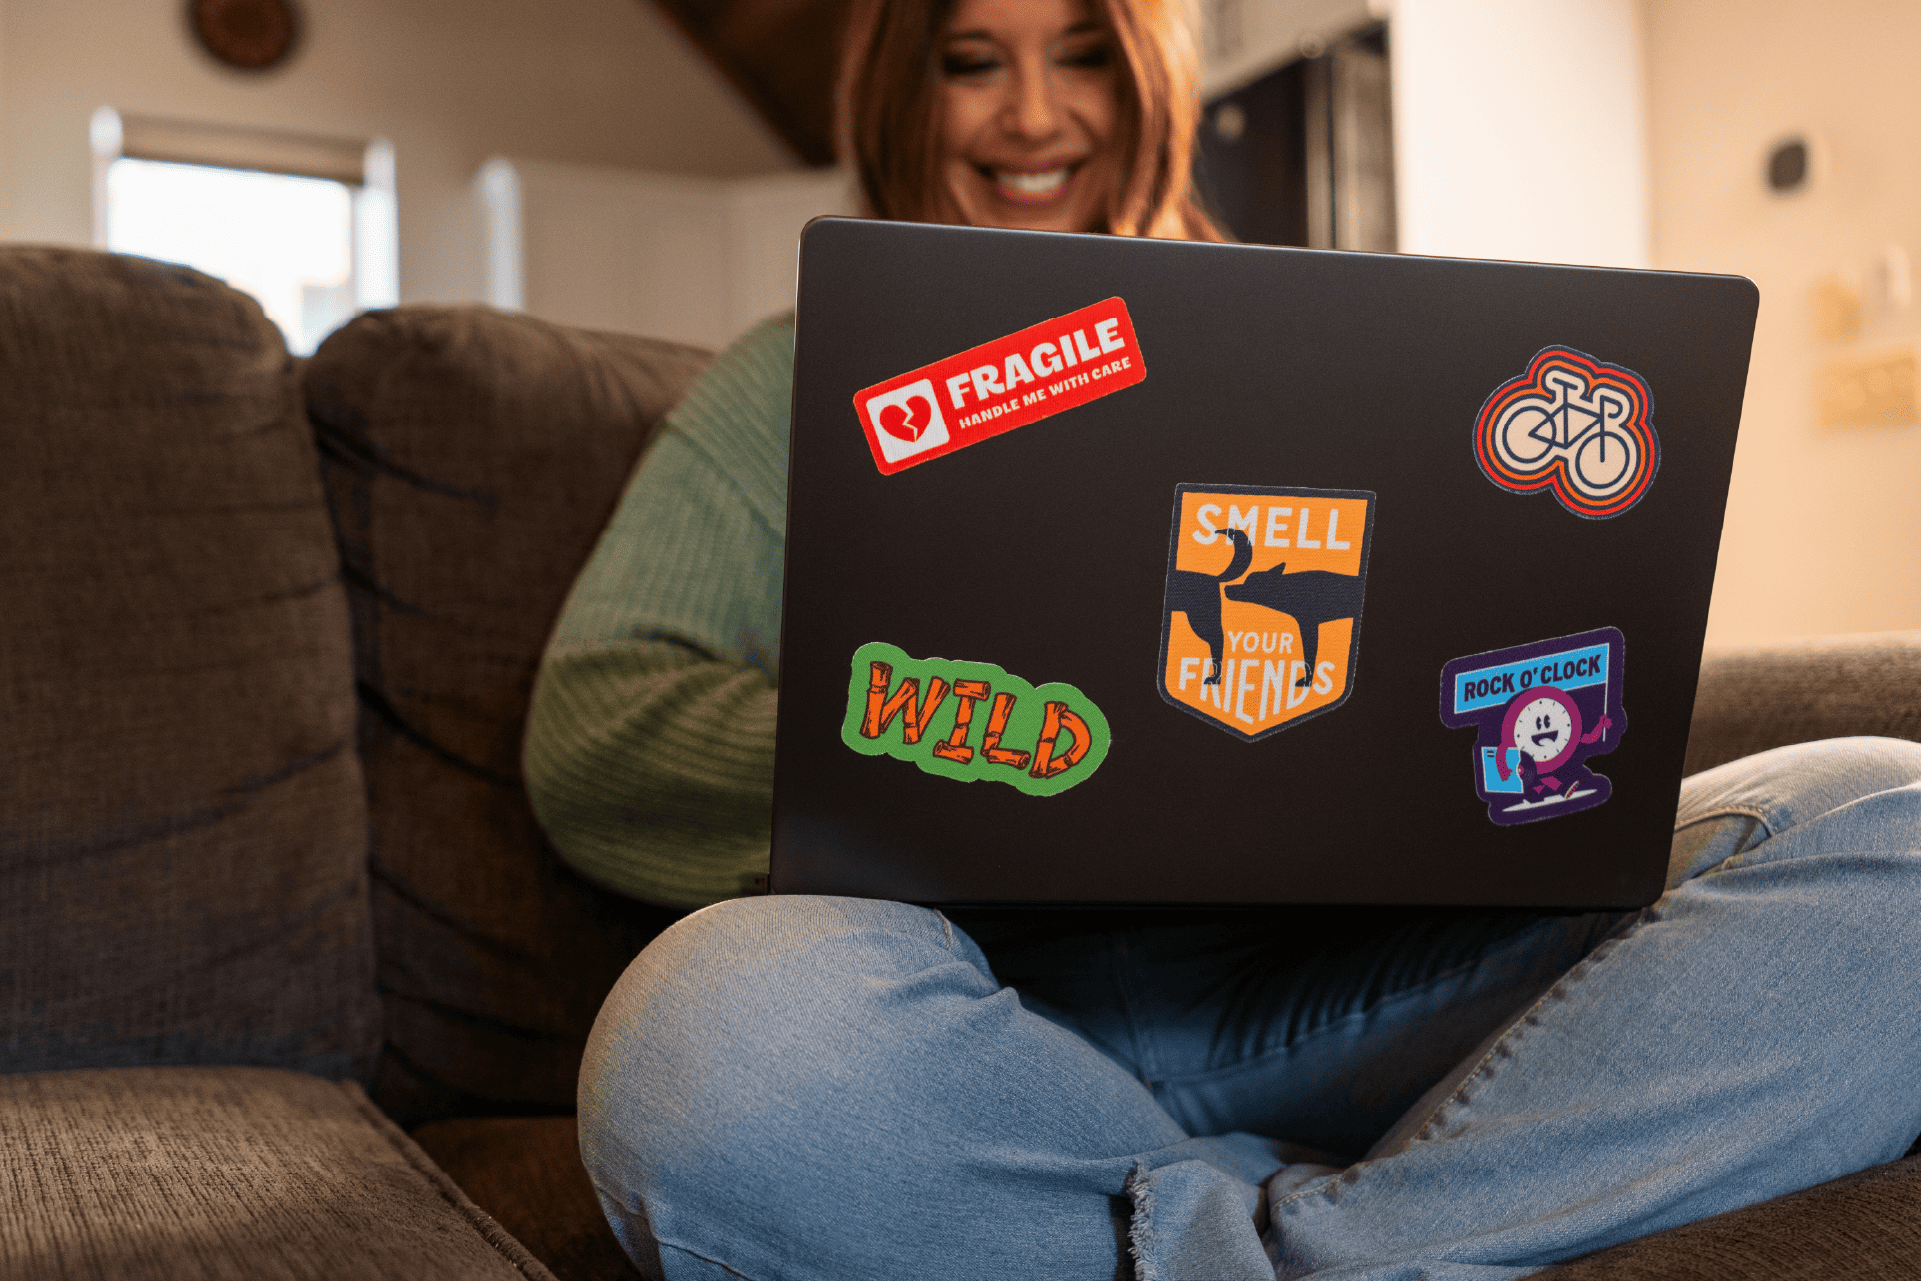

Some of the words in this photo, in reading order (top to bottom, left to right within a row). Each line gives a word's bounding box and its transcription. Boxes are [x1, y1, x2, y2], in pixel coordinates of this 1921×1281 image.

[946, 318, 1125, 410] FRAGILE
[959, 399, 1020, 429] HANDLE
[1023, 389, 1047, 407] ME
[1049, 373, 1090, 396] WITH
[1092, 357, 1131, 380] CARE
[1192, 503, 1351, 549] SMELL
[1227, 631, 1294, 654] YOUR
[1178, 657, 1336, 724] FRIENDS
[1464, 673, 1515, 702] ROCK
[1520, 654, 1601, 688] O'CLOCK
[859, 661, 1092, 780] WILD
